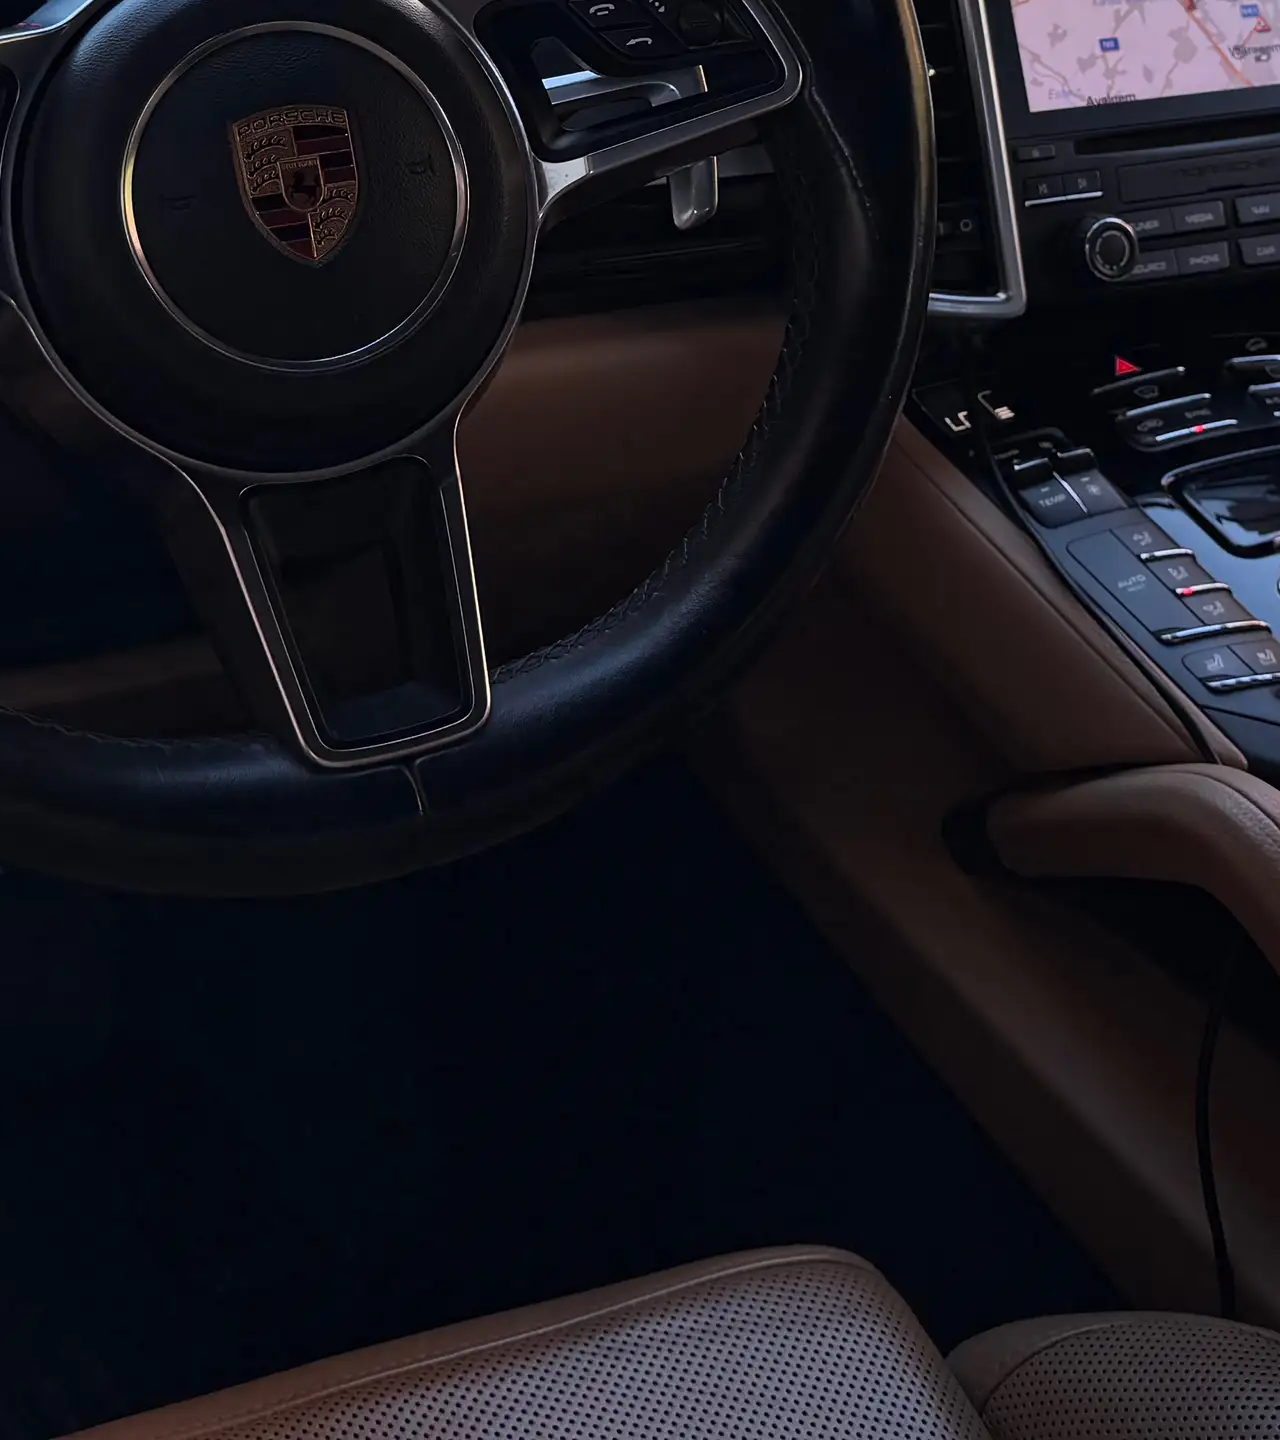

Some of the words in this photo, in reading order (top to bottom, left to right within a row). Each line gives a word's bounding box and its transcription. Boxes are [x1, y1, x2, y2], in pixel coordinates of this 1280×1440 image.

[238, 110, 347, 136] PORSCHE
[1038, 493, 1066, 508] TEMP
[1118, 574, 1146, 588] AUTO
